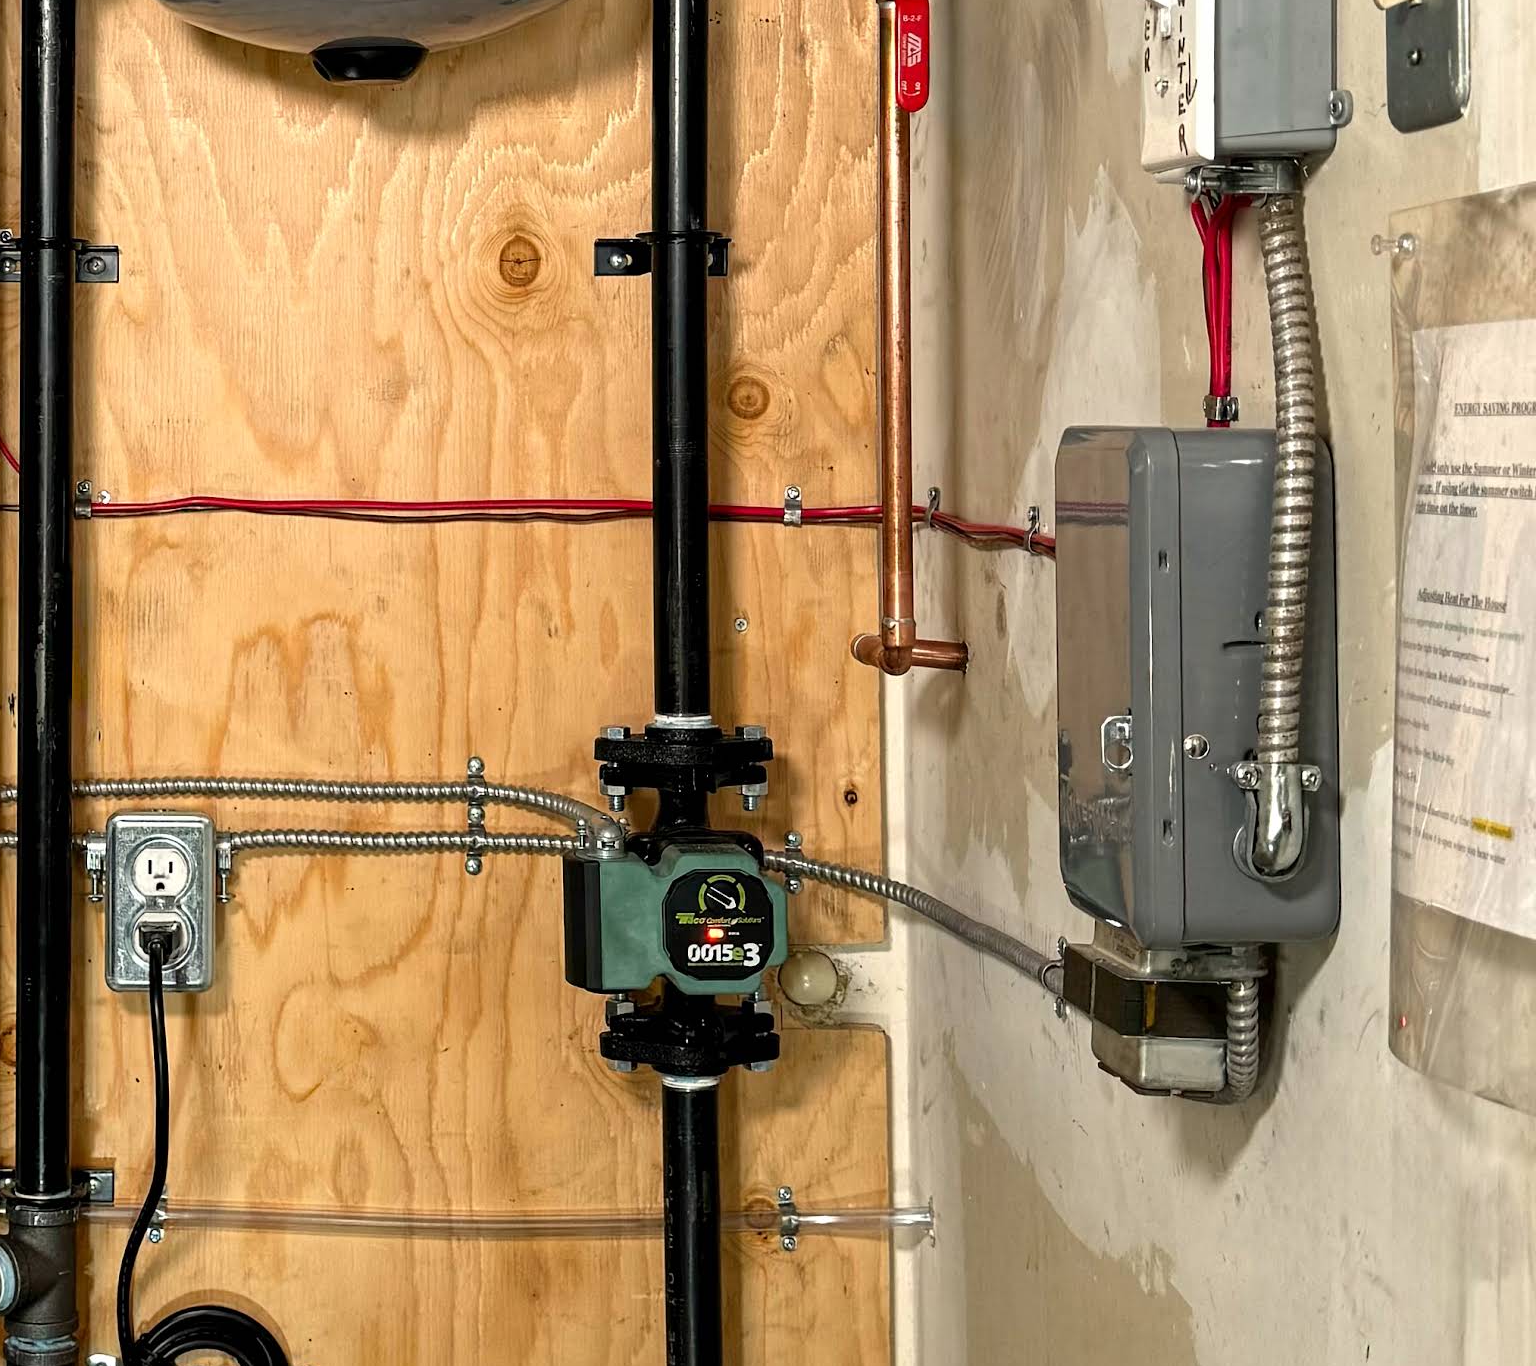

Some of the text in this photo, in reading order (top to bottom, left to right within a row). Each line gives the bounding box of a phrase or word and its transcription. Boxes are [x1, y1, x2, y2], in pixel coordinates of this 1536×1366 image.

[1455, 403, 1483, 415] ENERGY
[1483, 402, 1510, 415] SAVING
[1474, 463, 1502, 477] Summer
